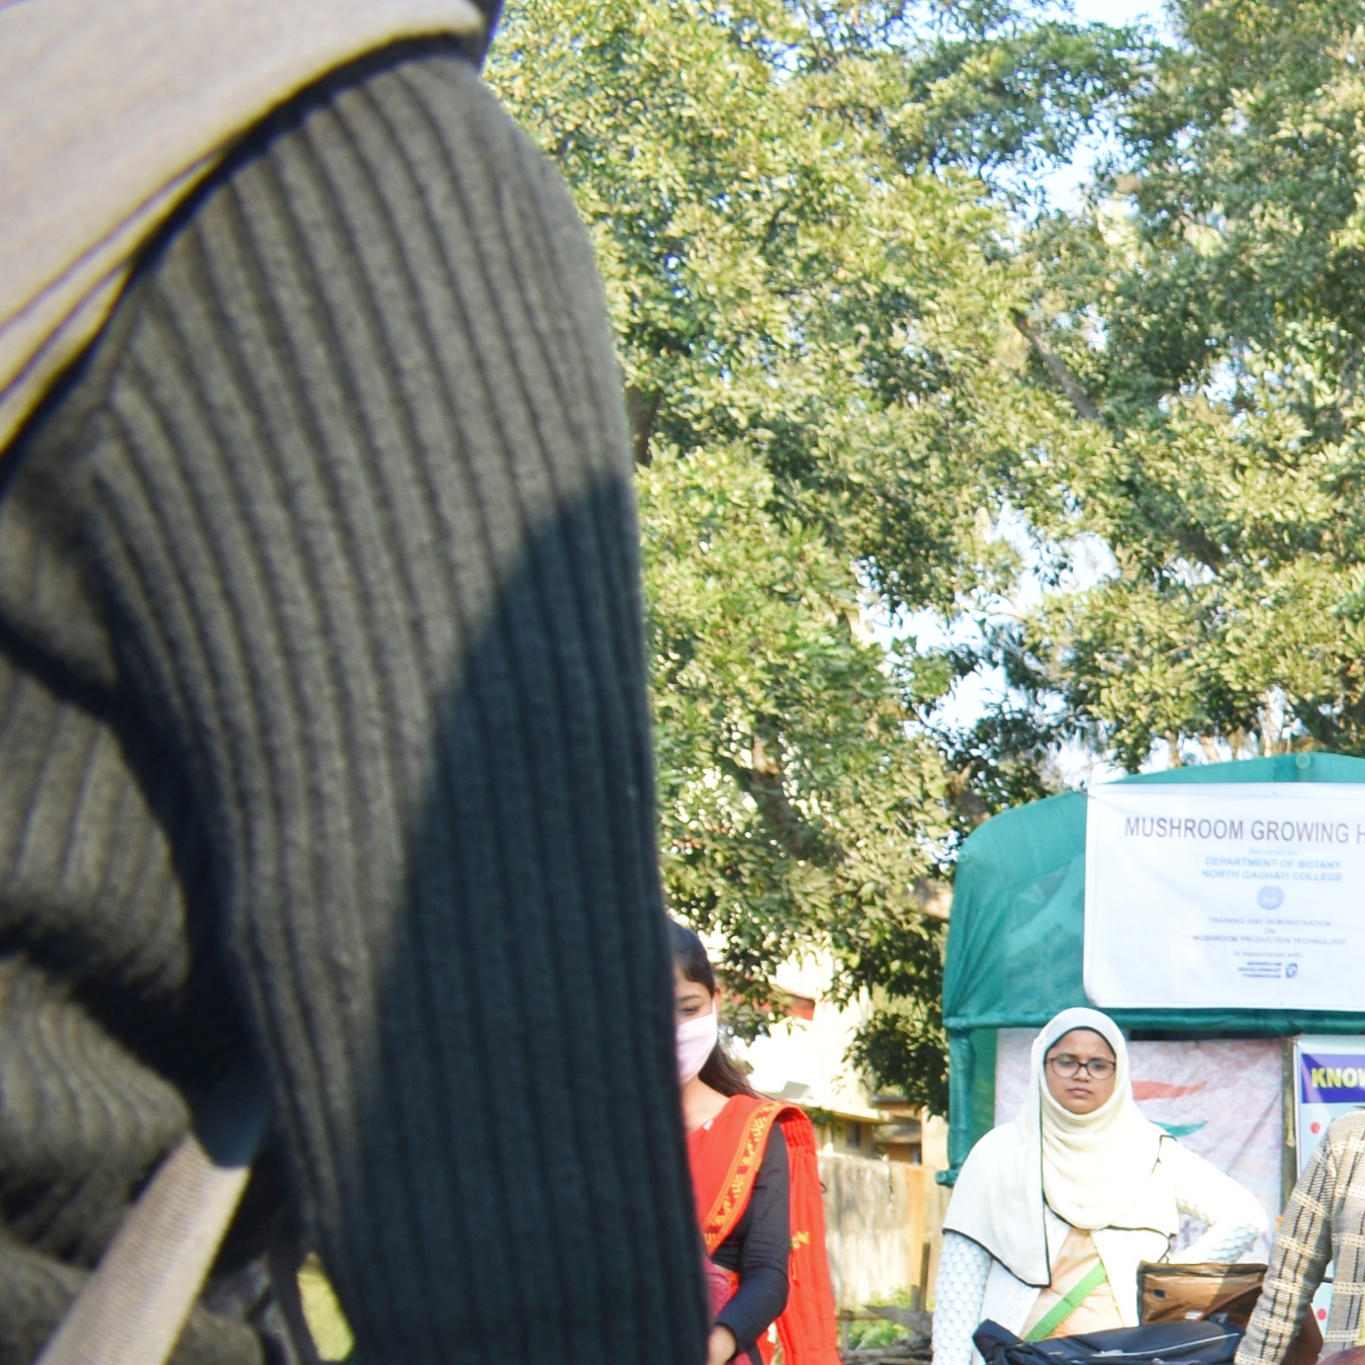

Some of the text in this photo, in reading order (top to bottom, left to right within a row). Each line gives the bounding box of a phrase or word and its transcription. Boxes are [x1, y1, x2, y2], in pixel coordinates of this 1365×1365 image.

[1124, 817, 1244, 840] MUSHROOM
[1251, 820, 1349, 843] GROWING
[1204, 856, 1341, 869] DEPARTMENT OF BOTANY
[1202, 869, 1343, 882] NORTH GAUHATI COLLEGE
[1209, 916, 1332, 927] TRAINING AND DEMONSTRATION
[1240, 936, 1290, 944] PRODUCTION
[1293, 937, 1346, 945] TECHNOLOGY
